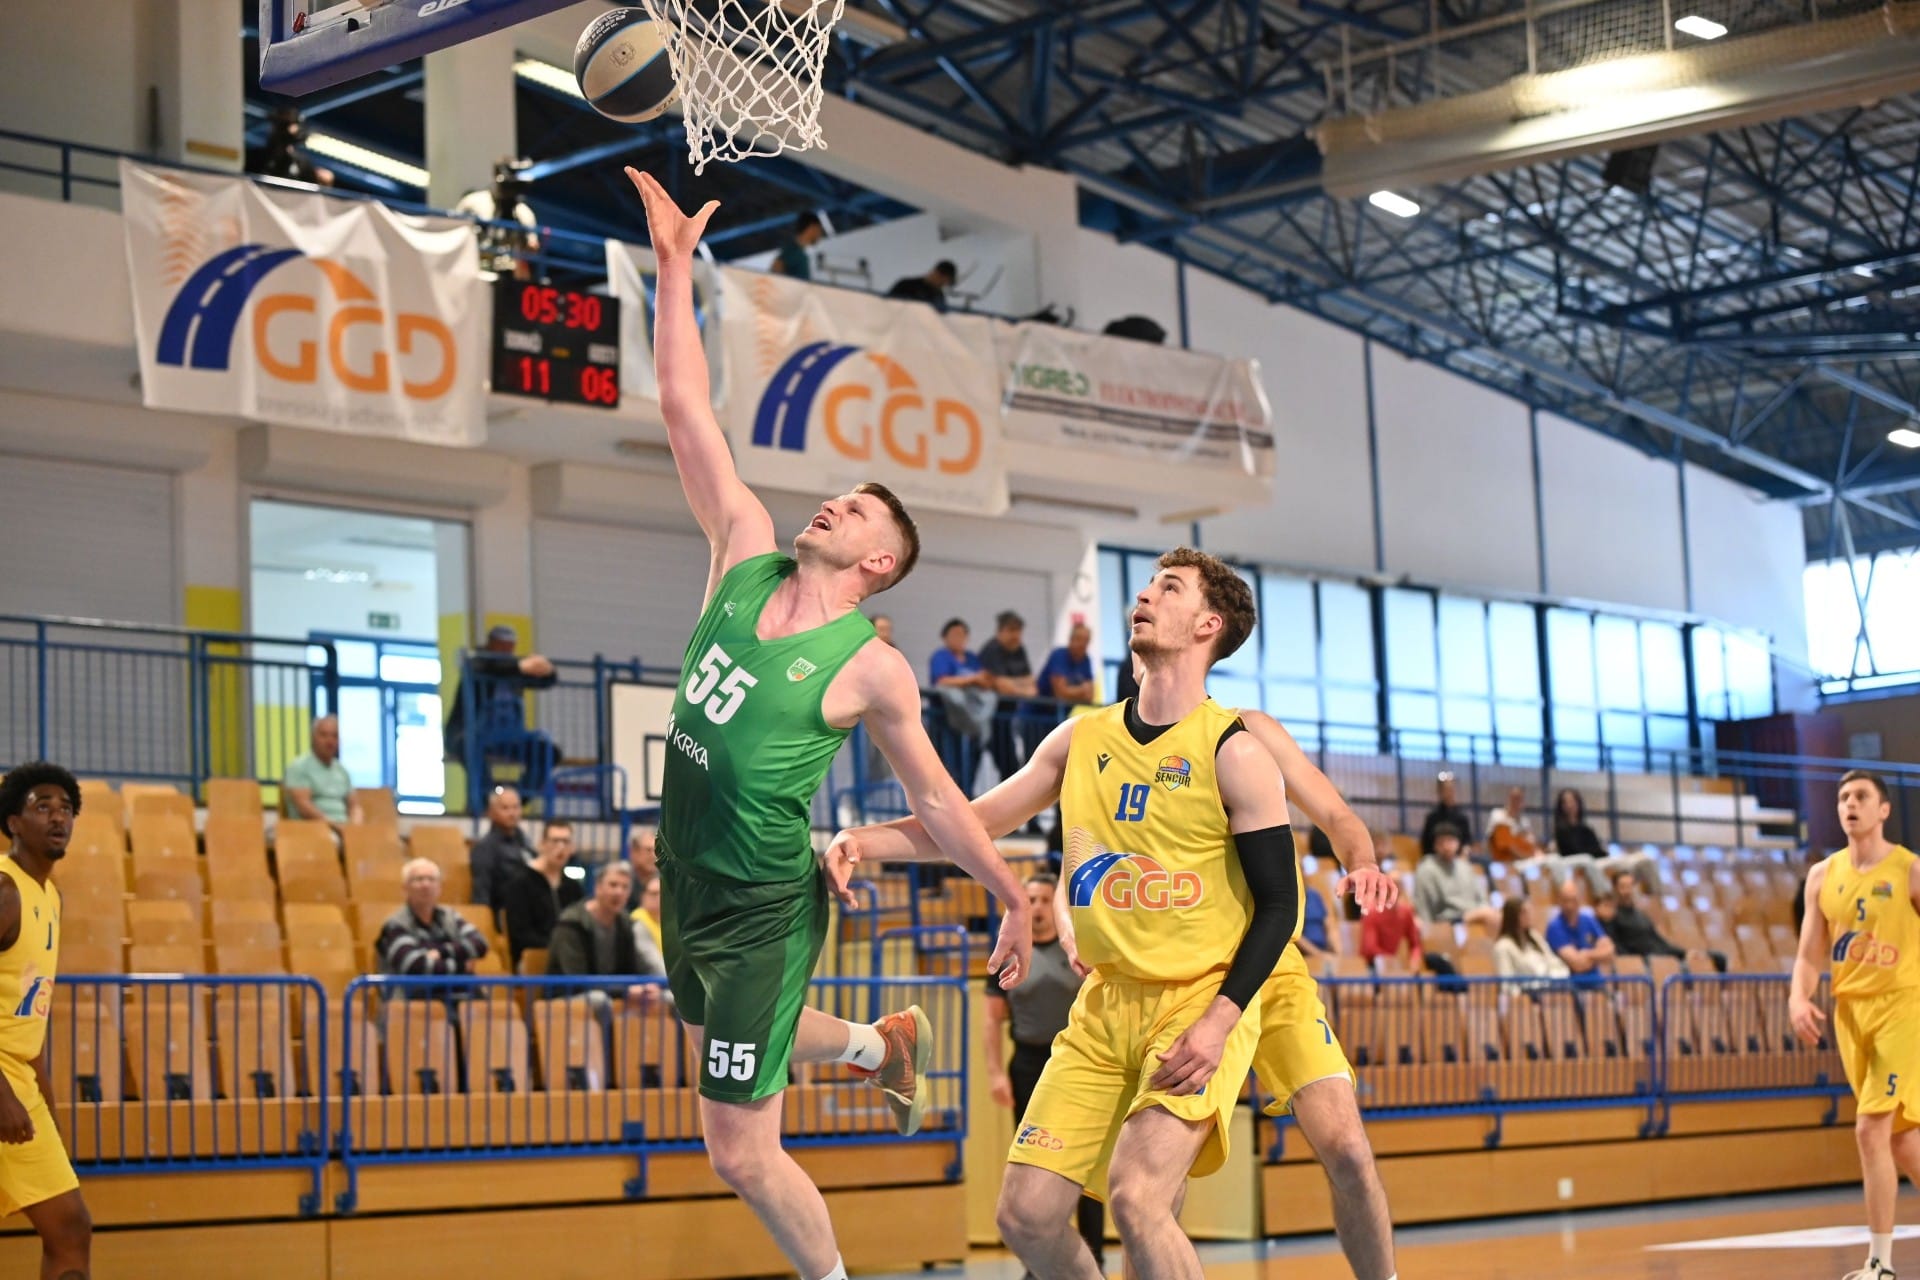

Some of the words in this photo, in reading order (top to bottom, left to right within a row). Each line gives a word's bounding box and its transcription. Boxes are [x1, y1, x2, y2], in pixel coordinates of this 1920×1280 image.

[521, 285, 602, 331] 05:30
[253, 293, 457, 401] GGD
[520, 356, 550, 395] 11
[581, 365, 619, 404] 06
[824, 383, 982, 475] GGD
[685, 642, 760, 725] 55
[673, 728, 709, 771] KRKA
[1114, 783, 1151, 822] 19
[1101, 870, 1203, 911] GGD
[1856, 897, 1866, 923] 5
[708, 1038, 756, 1081] 55
[1885, 1073, 1899, 1097] 5
